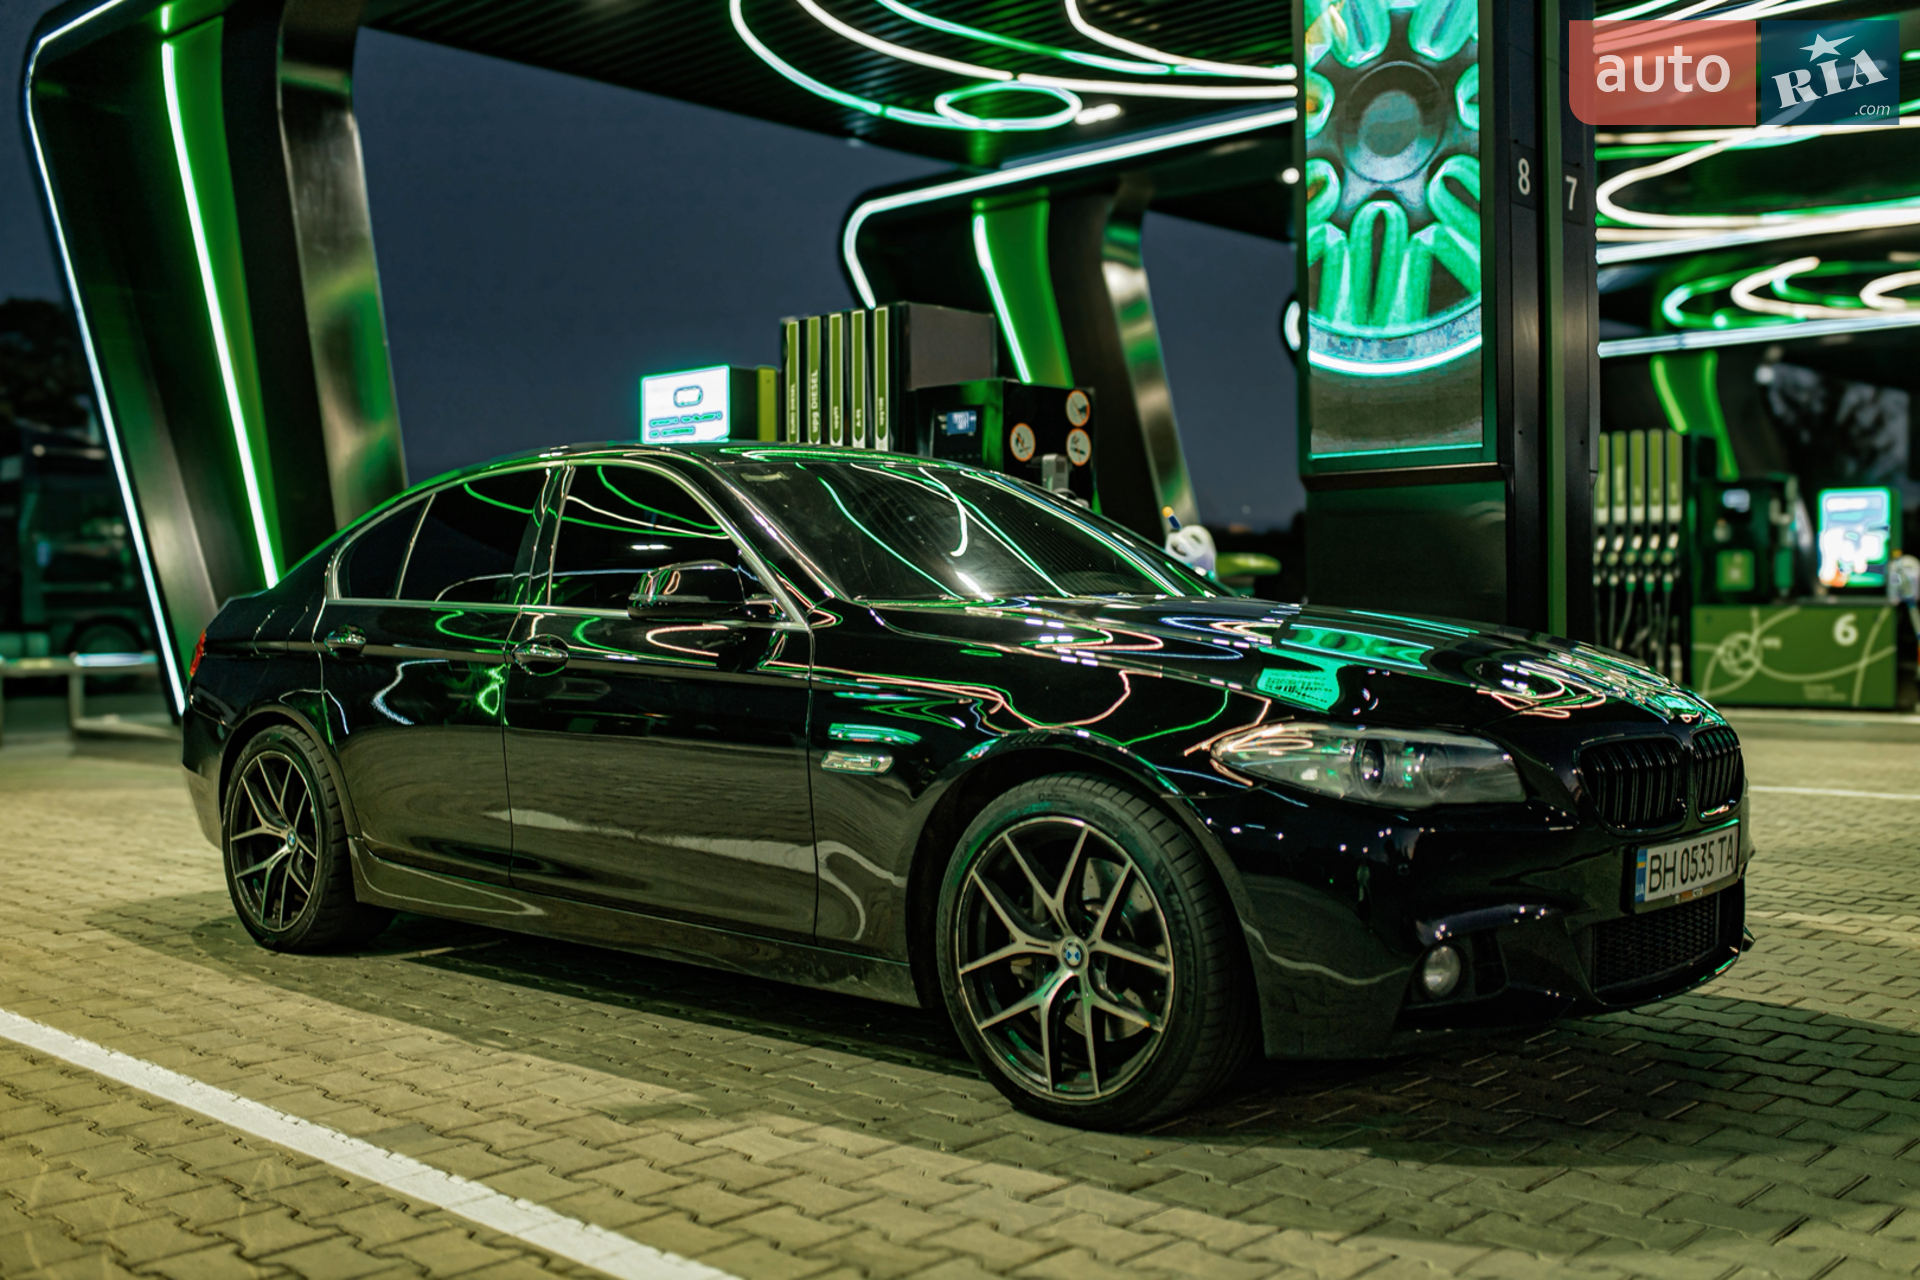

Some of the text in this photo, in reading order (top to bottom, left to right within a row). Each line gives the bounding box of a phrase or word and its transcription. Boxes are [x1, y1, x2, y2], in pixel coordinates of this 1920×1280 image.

[1518, 157, 1531, 195] 8
[1565, 174, 1578, 211] 7
[811, 369, 819, 410] DIESEL
[1834, 614, 1858, 646] 6
[1648, 834, 1734, 893] BH 0535 TA
